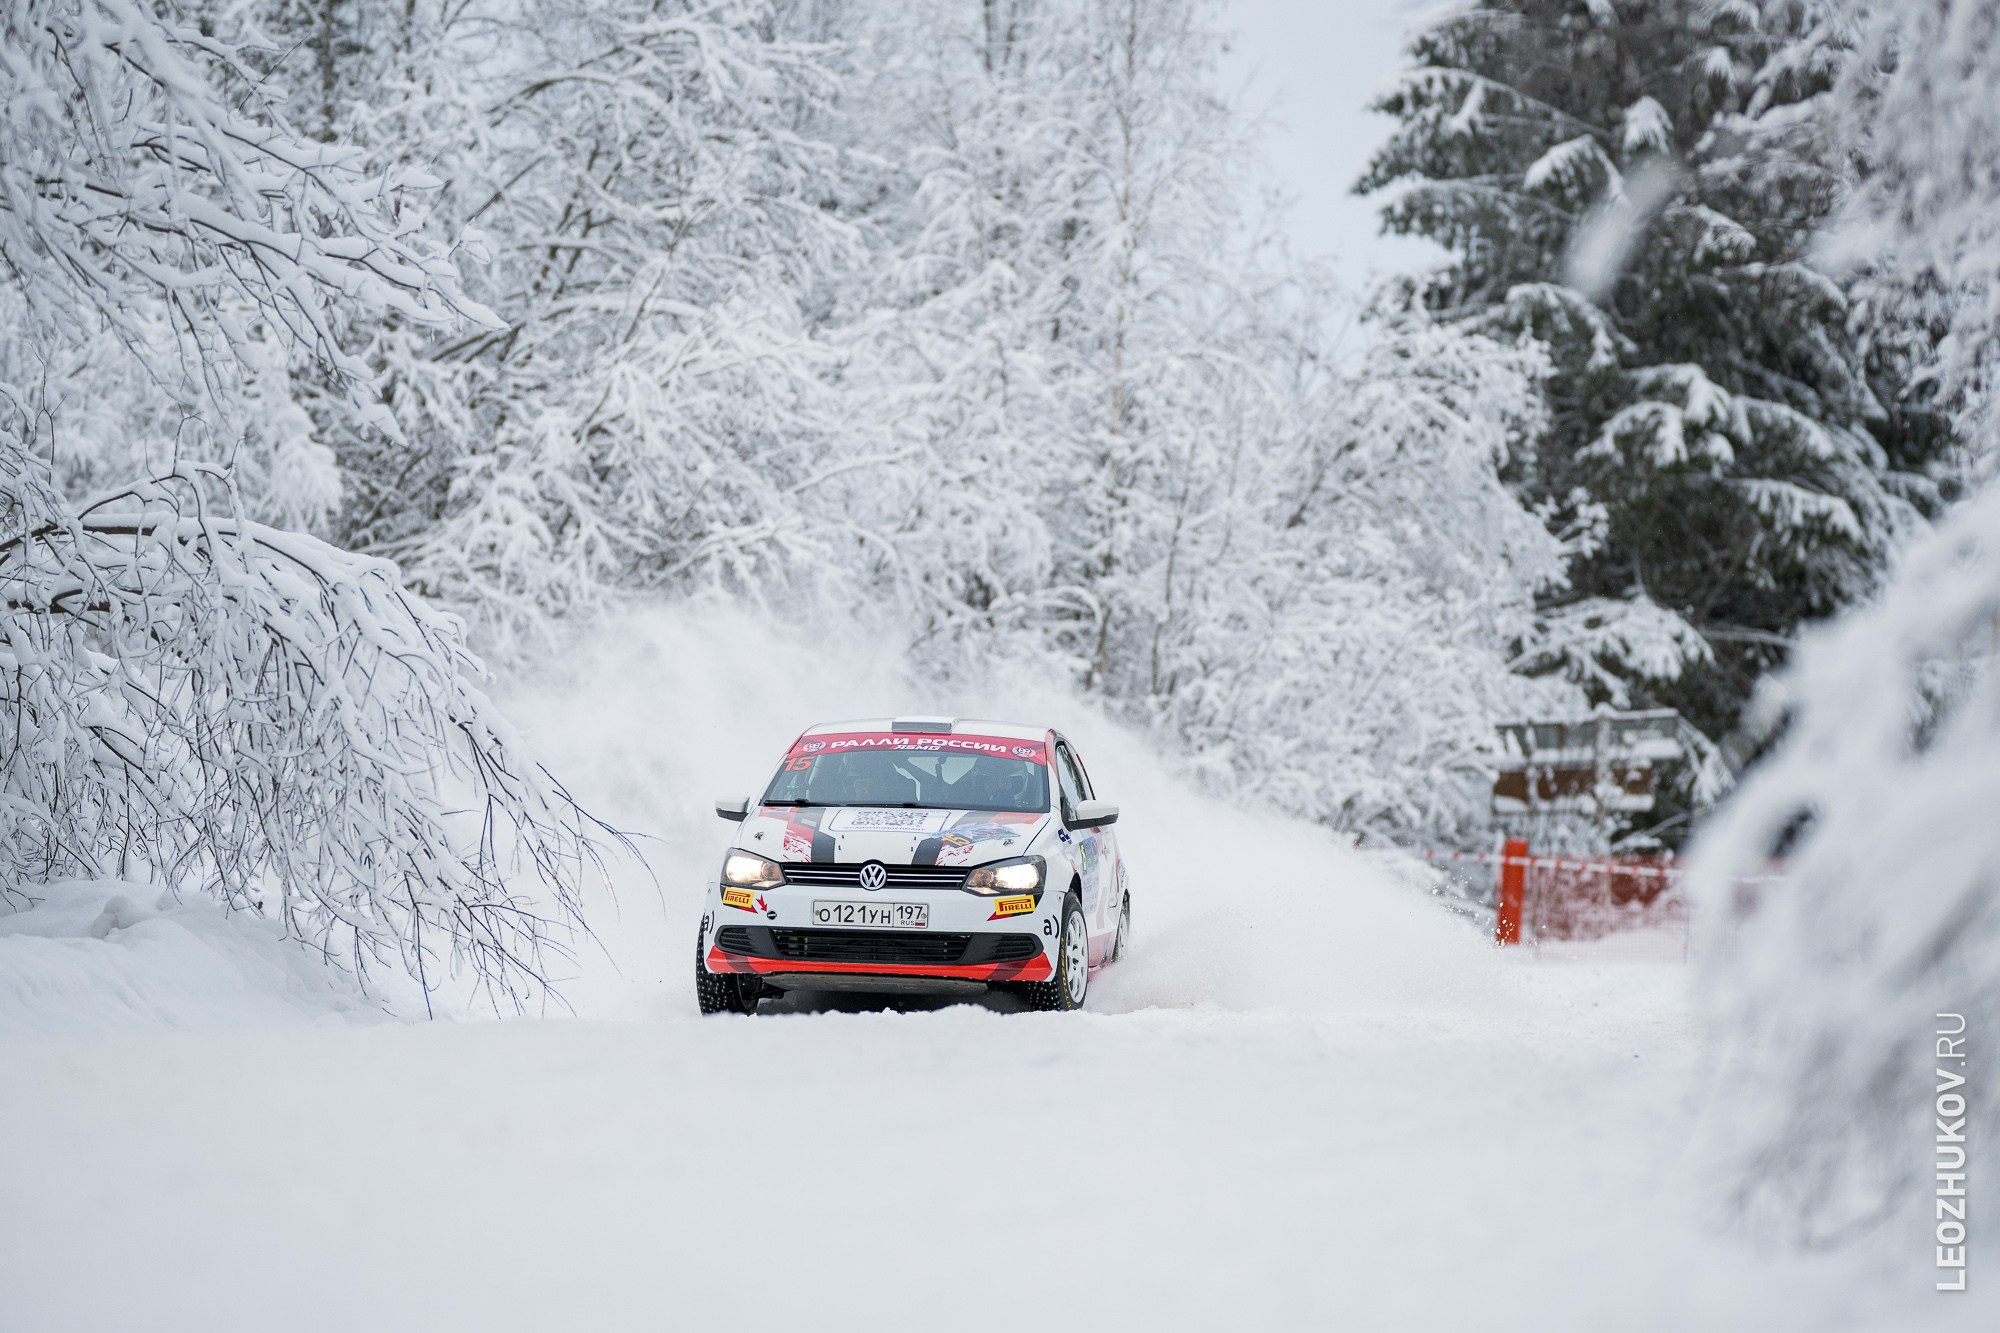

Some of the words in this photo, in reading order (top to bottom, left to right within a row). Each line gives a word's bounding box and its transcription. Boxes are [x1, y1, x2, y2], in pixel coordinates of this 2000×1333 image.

[831, 738, 909, 749] РАЛЛИ
[916, 738, 1007, 753] РОССИИ
[785, 756, 815, 772] 15
[941, 833, 971, 847] 15
[725, 890, 751, 904] PIRELLI
[998, 898, 1032, 912] PIRELLI
[896, 905, 923, 920] 197
